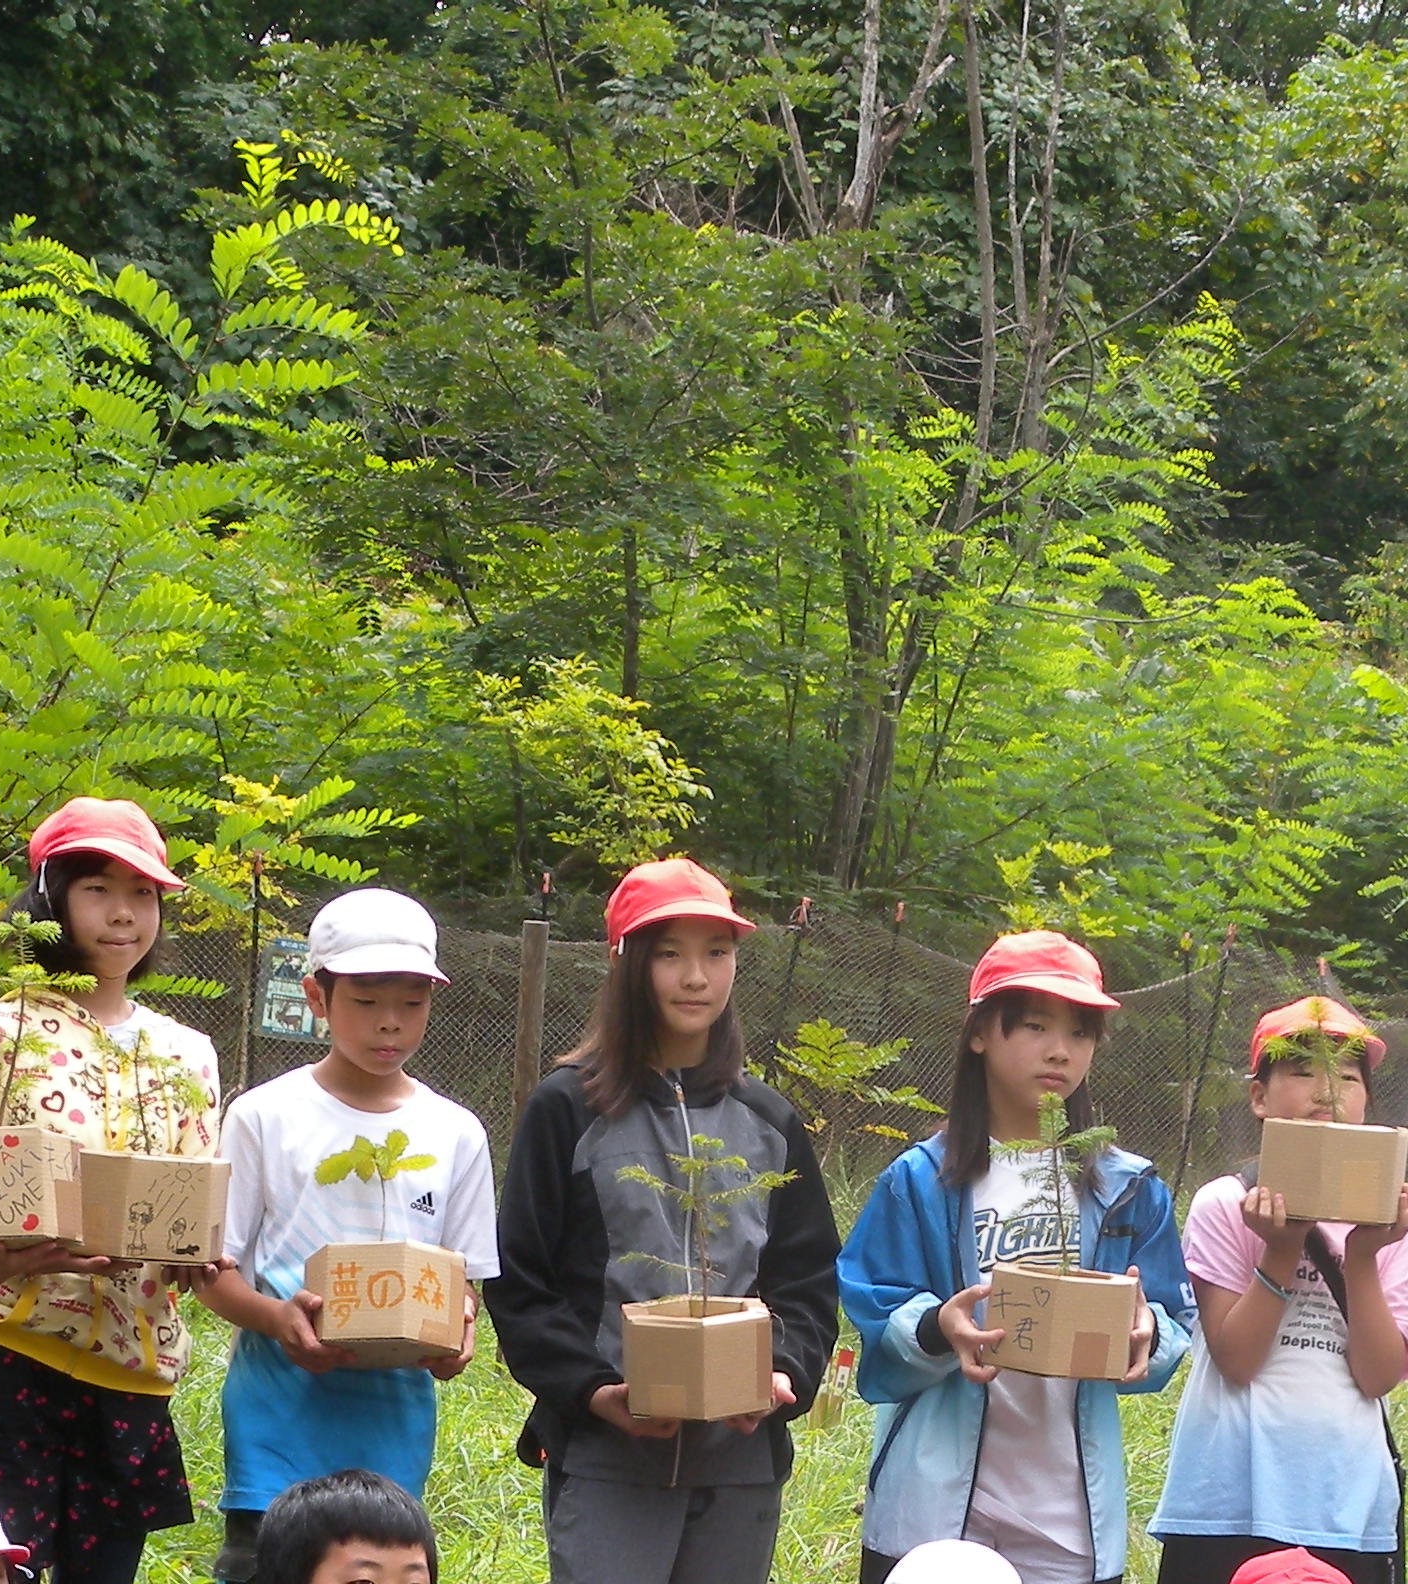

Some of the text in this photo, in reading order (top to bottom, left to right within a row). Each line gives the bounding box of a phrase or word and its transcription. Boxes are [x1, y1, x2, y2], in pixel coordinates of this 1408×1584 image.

[410, 1201, 436, 1216] adidas
[329, 1261, 445, 1329] 夢の森
[1013, 1317, 1039, 1352] 君
